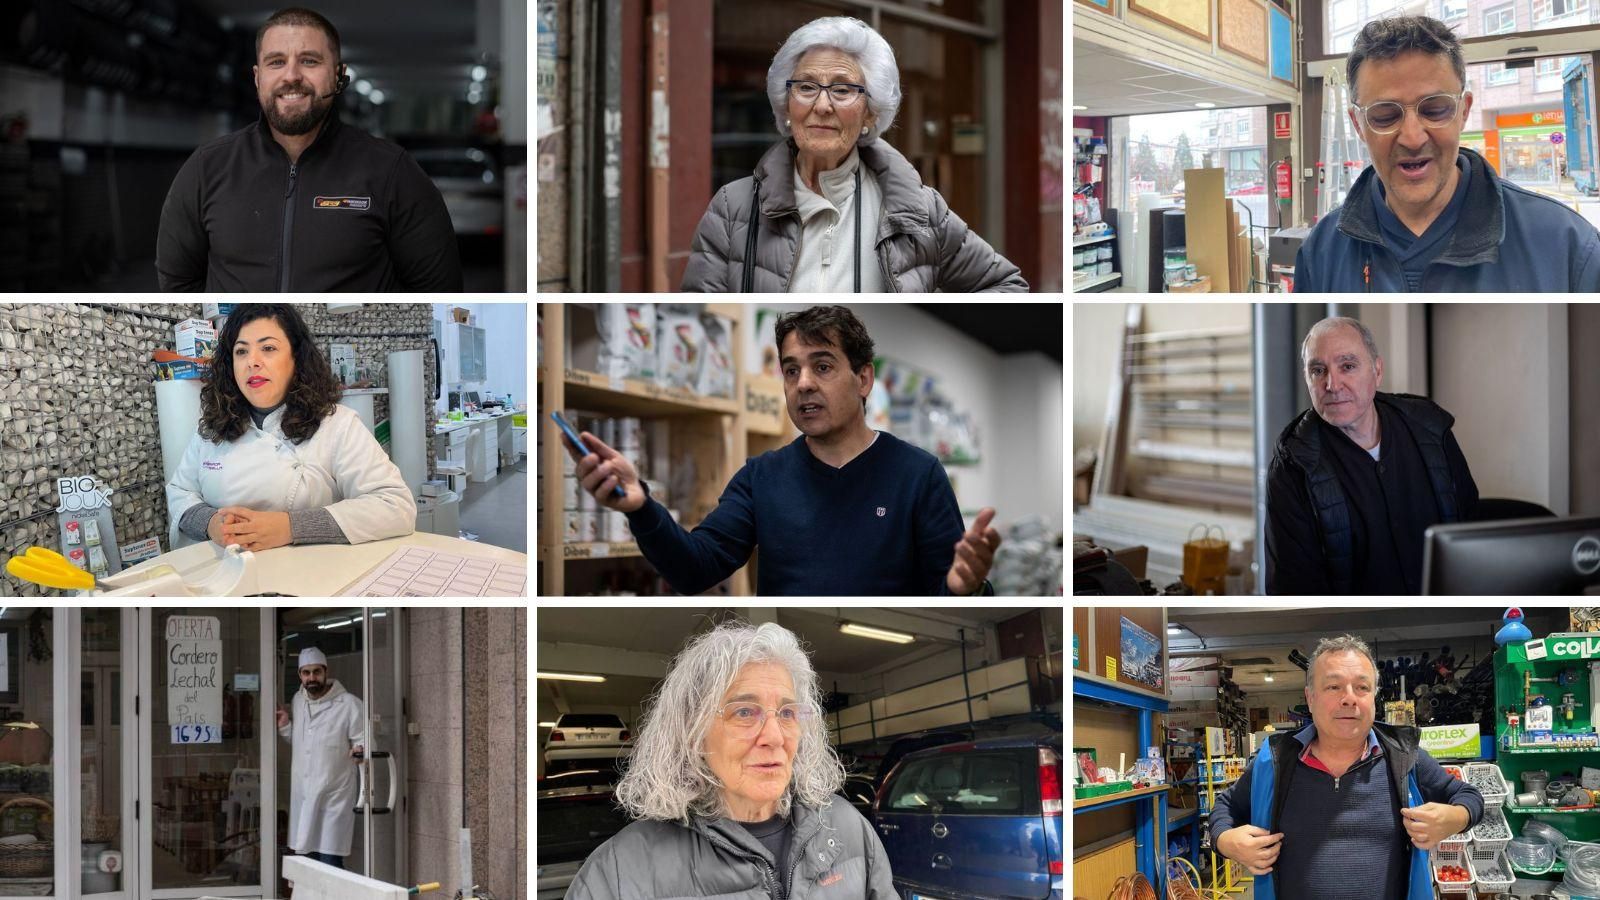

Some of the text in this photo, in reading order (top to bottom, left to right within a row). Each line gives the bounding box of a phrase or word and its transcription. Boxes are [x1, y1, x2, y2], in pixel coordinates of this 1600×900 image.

[58, 490, 111, 511] JOUX
[167, 619, 214, 639] OFERTA
[170, 643, 218, 665] Cordero
[170, 667, 216, 688] Lechal
